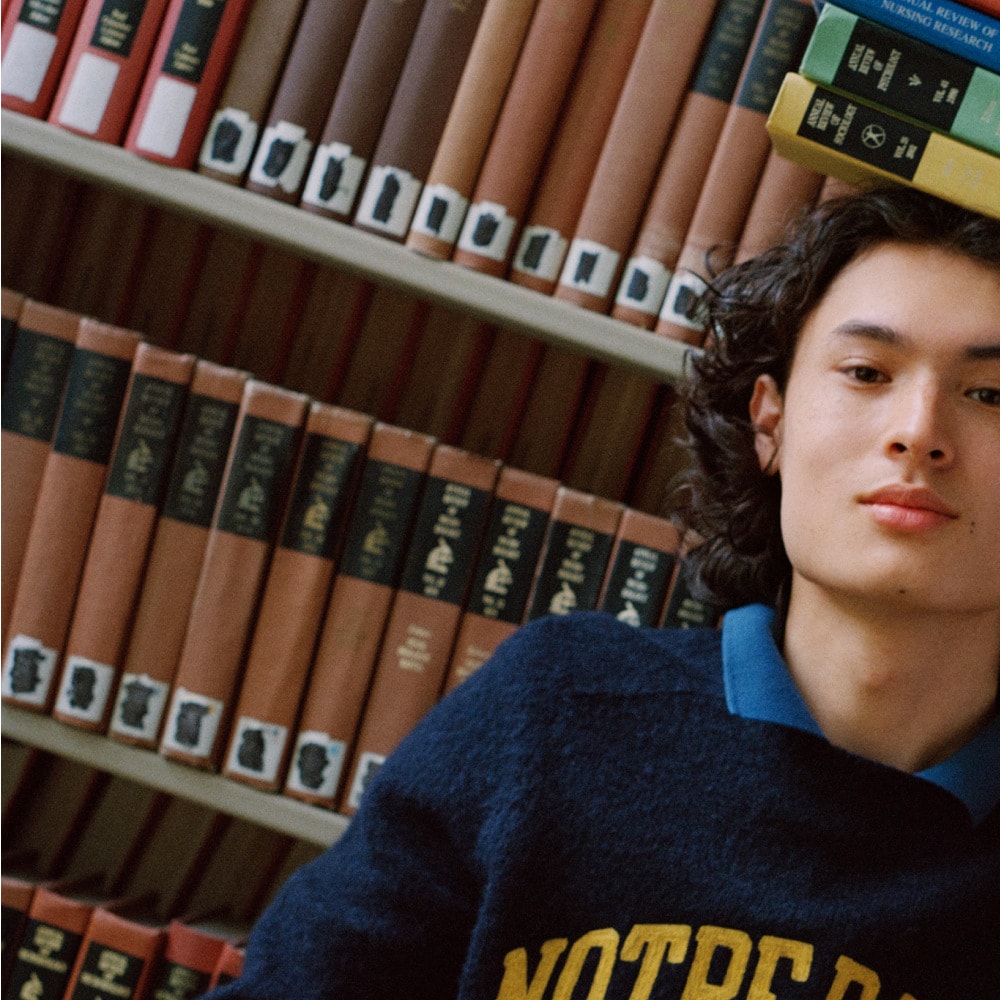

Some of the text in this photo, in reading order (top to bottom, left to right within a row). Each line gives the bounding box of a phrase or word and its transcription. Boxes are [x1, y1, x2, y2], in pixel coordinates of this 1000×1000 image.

[880, 0, 994, 53] NURSING RESEARCH
[936, 7, 980, 31] REVIEW
[982, 25, 999, 39] OF
